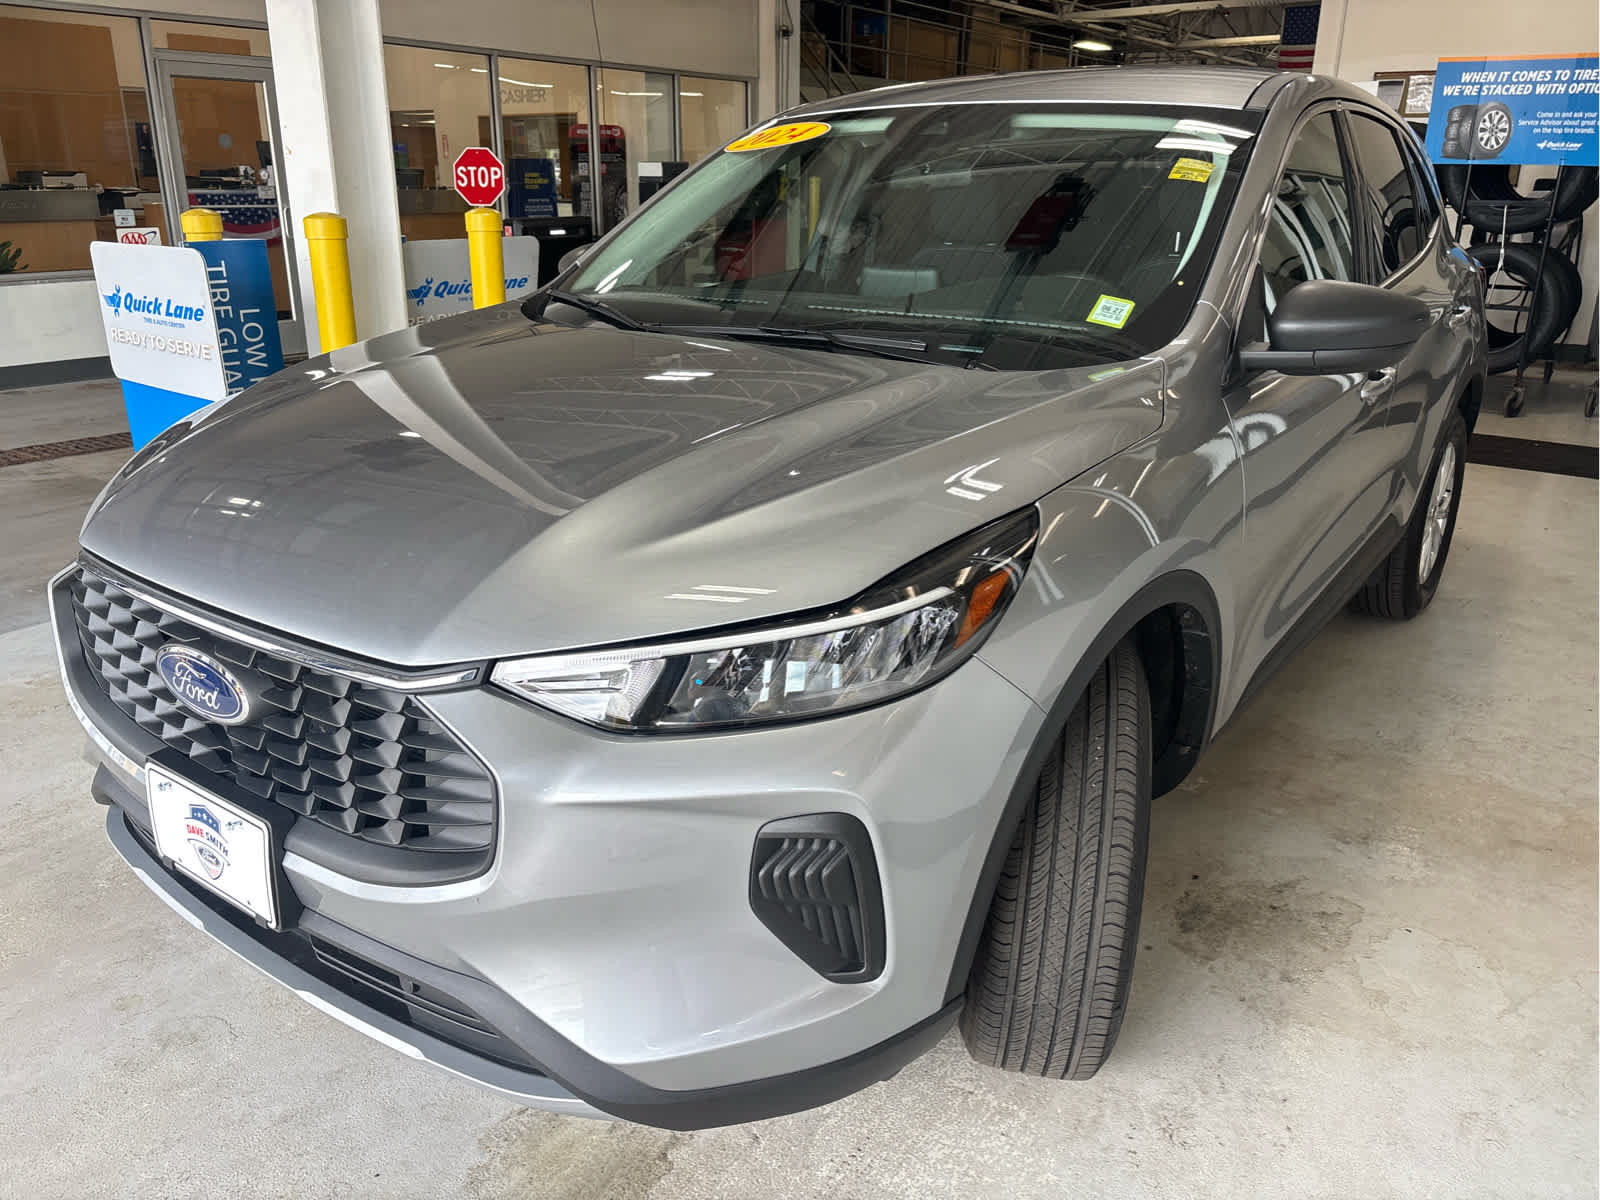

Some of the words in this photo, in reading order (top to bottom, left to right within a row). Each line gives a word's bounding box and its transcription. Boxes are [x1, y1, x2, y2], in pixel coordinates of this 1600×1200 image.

[1443, 85, 1480, 96] WE'RE
[1481, 84, 1532, 96] STACKED
[1535, 83, 1566, 95] WITH
[1461, 71, 1497, 83] WHEN
[1497, 71, 1510, 82] IT
[1511, 70, 1552, 82] COMES
[1554, 70, 1571, 81] TO
[1573, 69, 1599, 80] TIRE
[501, 88, 547, 104] CASHIER
[456, 165, 501, 188] STOP
[206, 259, 234, 319] TIRE
[434, 280, 473, 298] Quic
[504, 277, 529, 290] ne
[123, 292, 163, 317] Quick
[164, 298, 205, 323] Lane
[110, 327, 147, 347] READY
[148, 333, 166, 352] TO
[167, 336, 213, 362] SERVE
[239, 308, 269, 368] LOW
[218, 327, 245, 396] GUA
[171, 661, 221, 710] Ford
[186, 823, 205, 839] DAVE
[205, 831, 229, 858] SMITH
